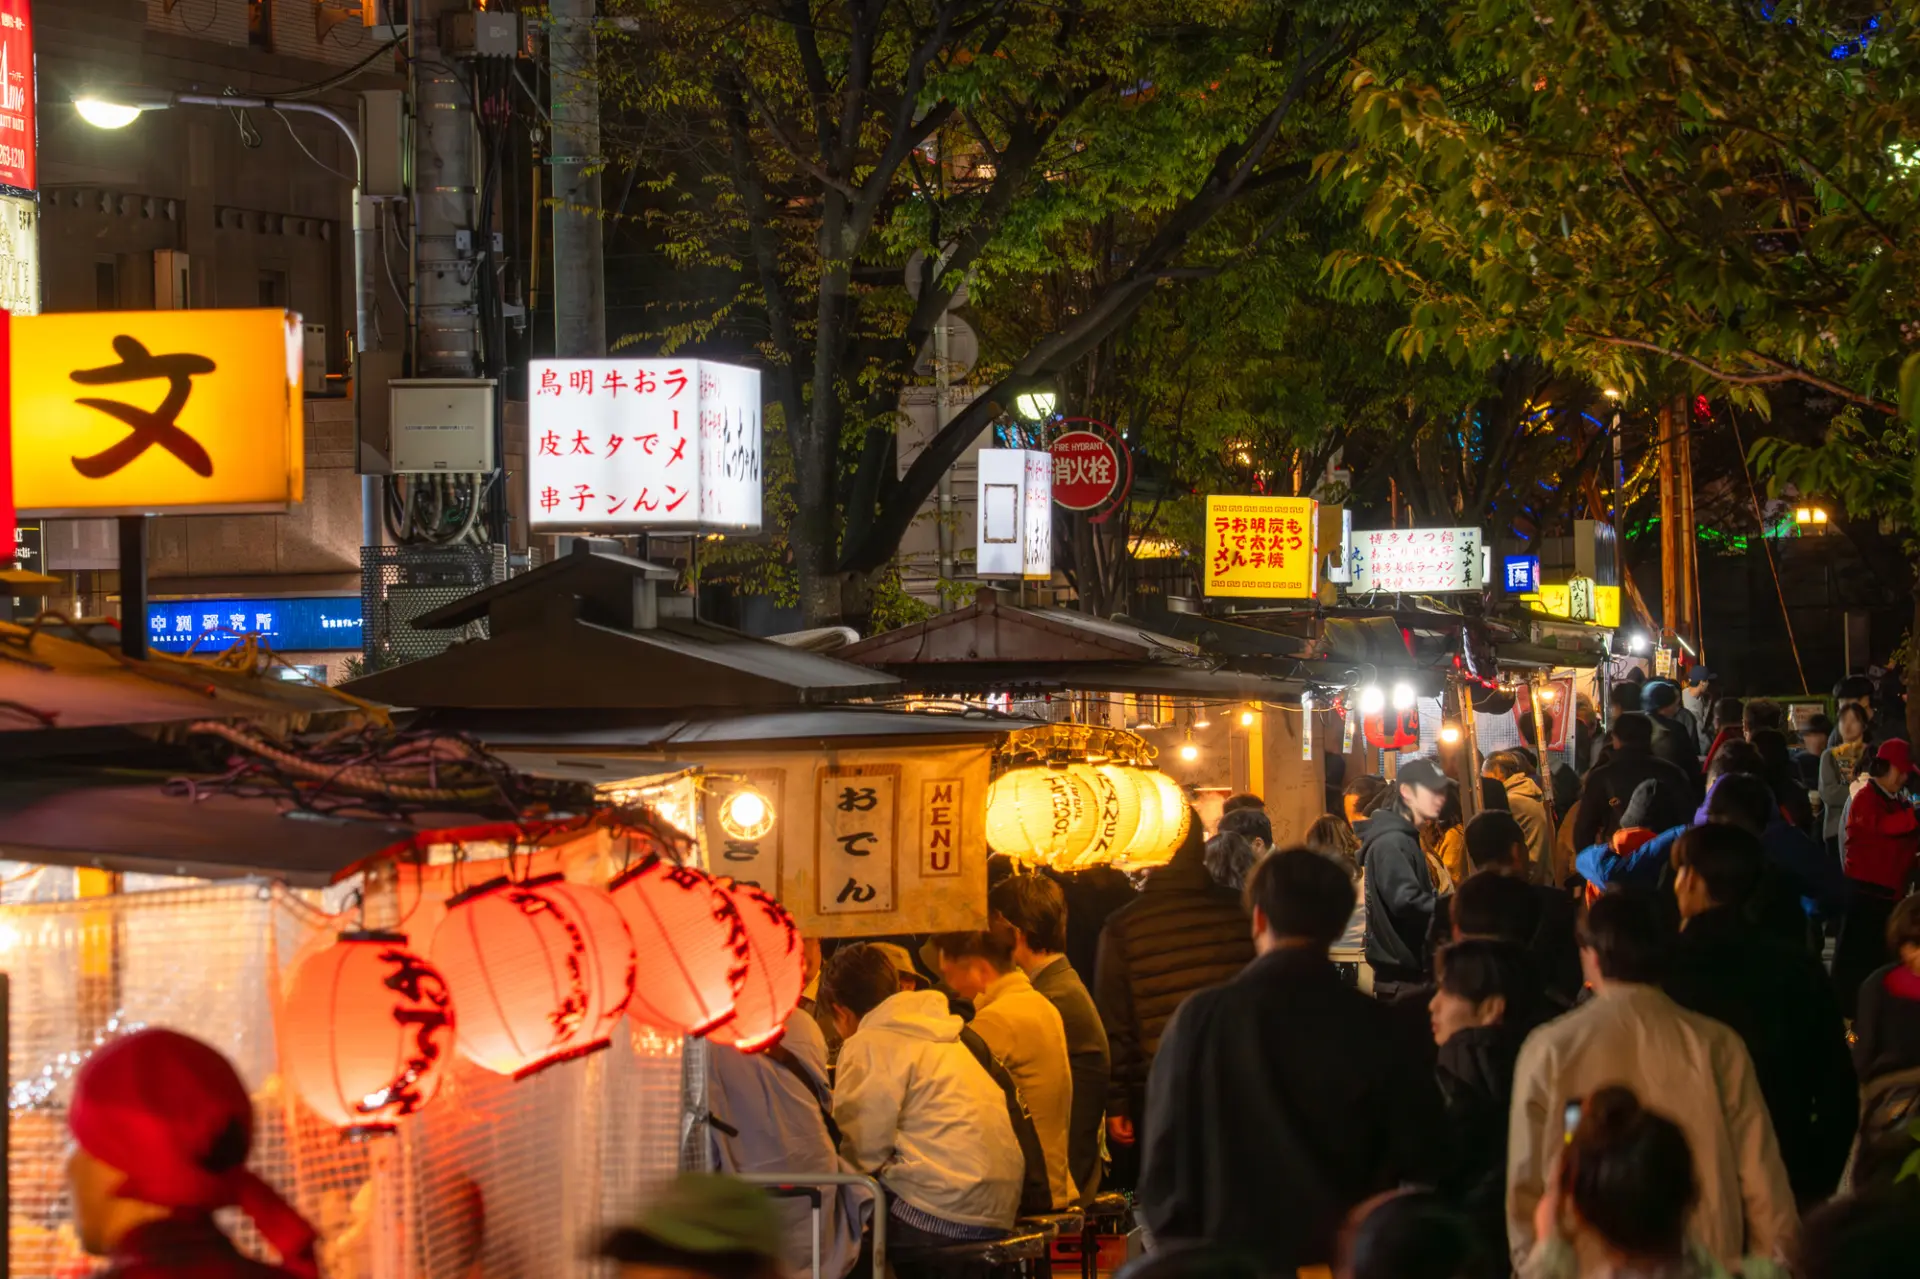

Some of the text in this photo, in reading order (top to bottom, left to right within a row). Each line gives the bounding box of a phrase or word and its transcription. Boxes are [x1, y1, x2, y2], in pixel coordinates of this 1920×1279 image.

[69, 335, 216, 479] 文
[537, 368, 563, 514] 鳥皮串
[569, 369, 595, 512] 明太子
[601, 370, 628, 515] 牛タン
[633, 369, 660, 512] おでん
[663, 368, 690, 513] ラーメン
[1052, 455, 1111, 486] 消火栓
[1054, 442, 1103, 452] FIRE HYDRANT
[1214, 517, 1230, 576] ラーメン
[1231, 518, 1248, 567] おでん
[1250, 518, 1266, 568] 明太子
[1268, 518, 1284, 568] 炭火焼
[1286, 518, 1302, 550] もつ
[1369, 531, 1454, 544] 博多もつ鍋
[836, 787, 878, 903] おでん
[930, 785, 952, 871] MENU
